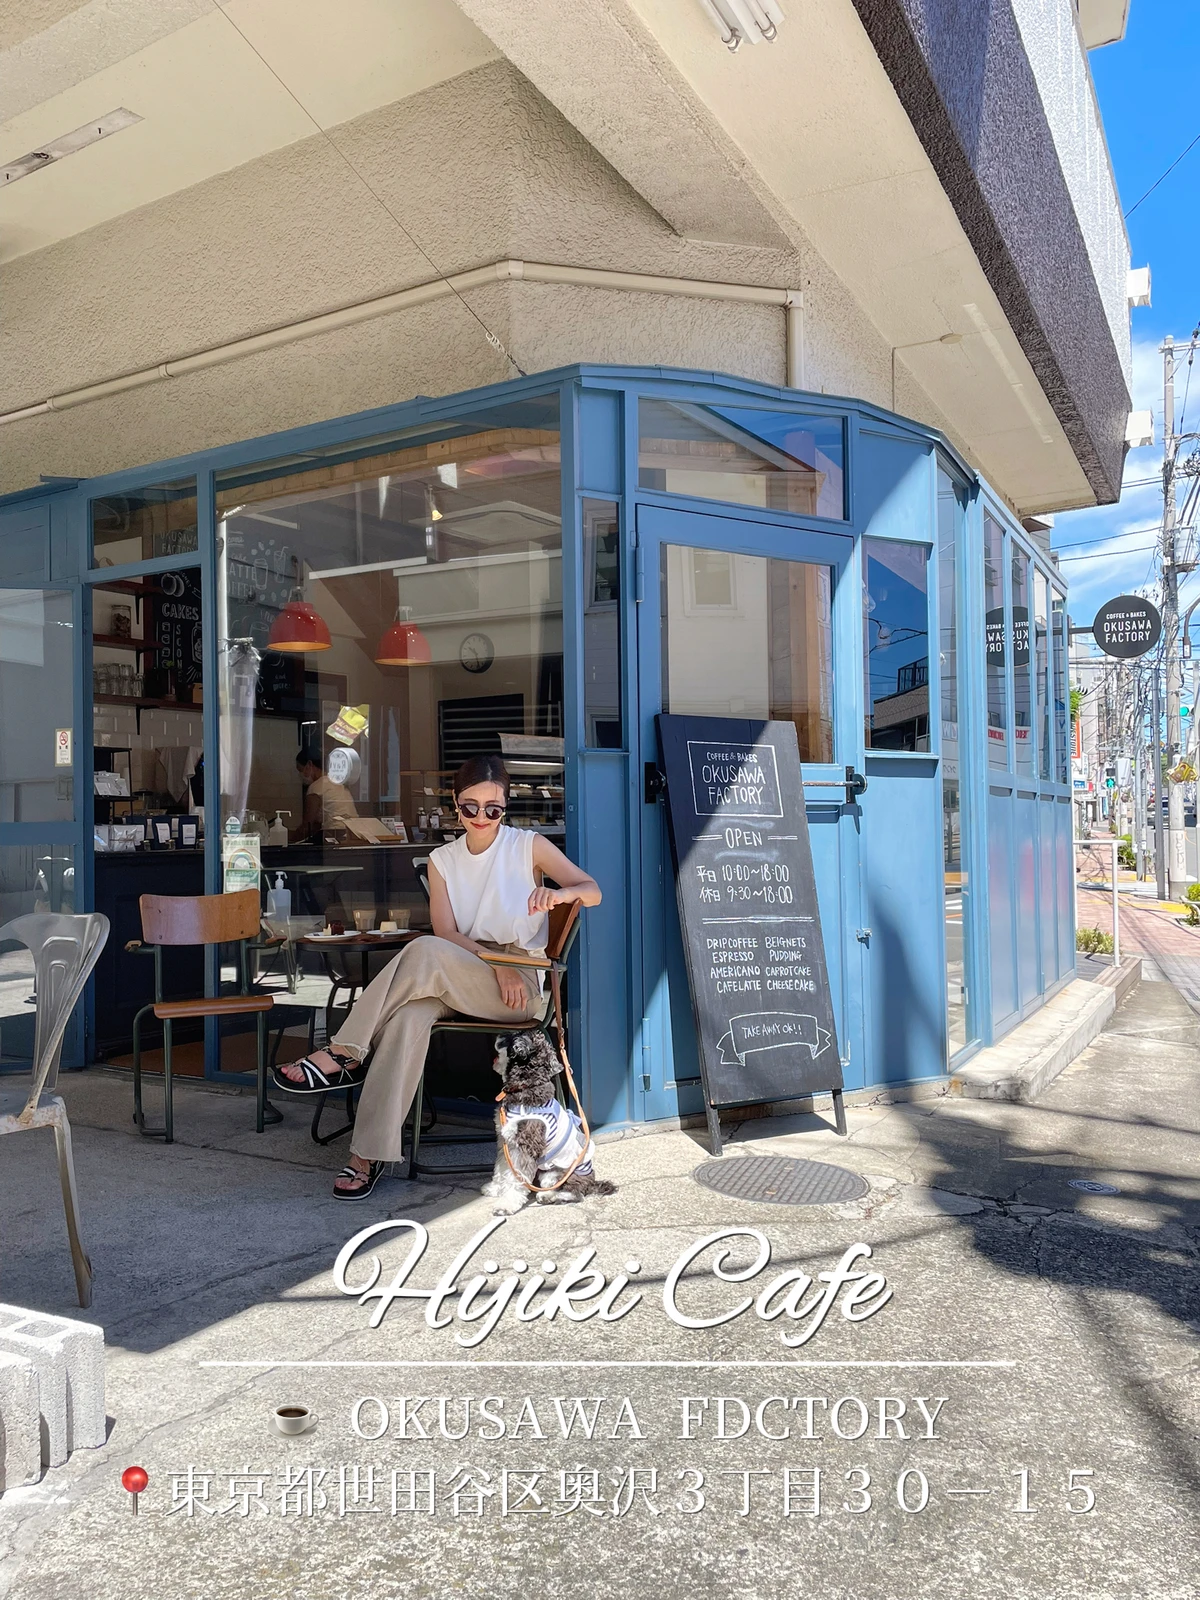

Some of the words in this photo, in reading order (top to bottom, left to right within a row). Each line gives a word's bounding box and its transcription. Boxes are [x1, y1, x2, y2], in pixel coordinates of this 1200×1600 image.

[161, 602, 199, 621] CAKES
[1106, 612, 1125, 620] COFFEE
[1104, 620, 1151, 633] OKUSAWA
[1105, 631, 1151, 643] FACTORY
[707, 752, 729, 761] COFFEE
[737, 752, 757, 763] BAKES
[702, 765, 766, 785] OKUSAWA
[708, 786, 763, 805] FACTORY
[725, 828, 762, 848] OPEN
[696, 865, 717, 883] 平日
[700, 886, 721, 903] 休日
[765, 936, 806, 949] BEIGNETS
[712, 951, 754, 963] ESPRESSO
[769, 949, 802, 962] PUDDING
[710, 965, 760, 979] AMERICANO
[742, 1025, 760, 1040] TAKE
[762, 1023, 780, 1036] AWAY
